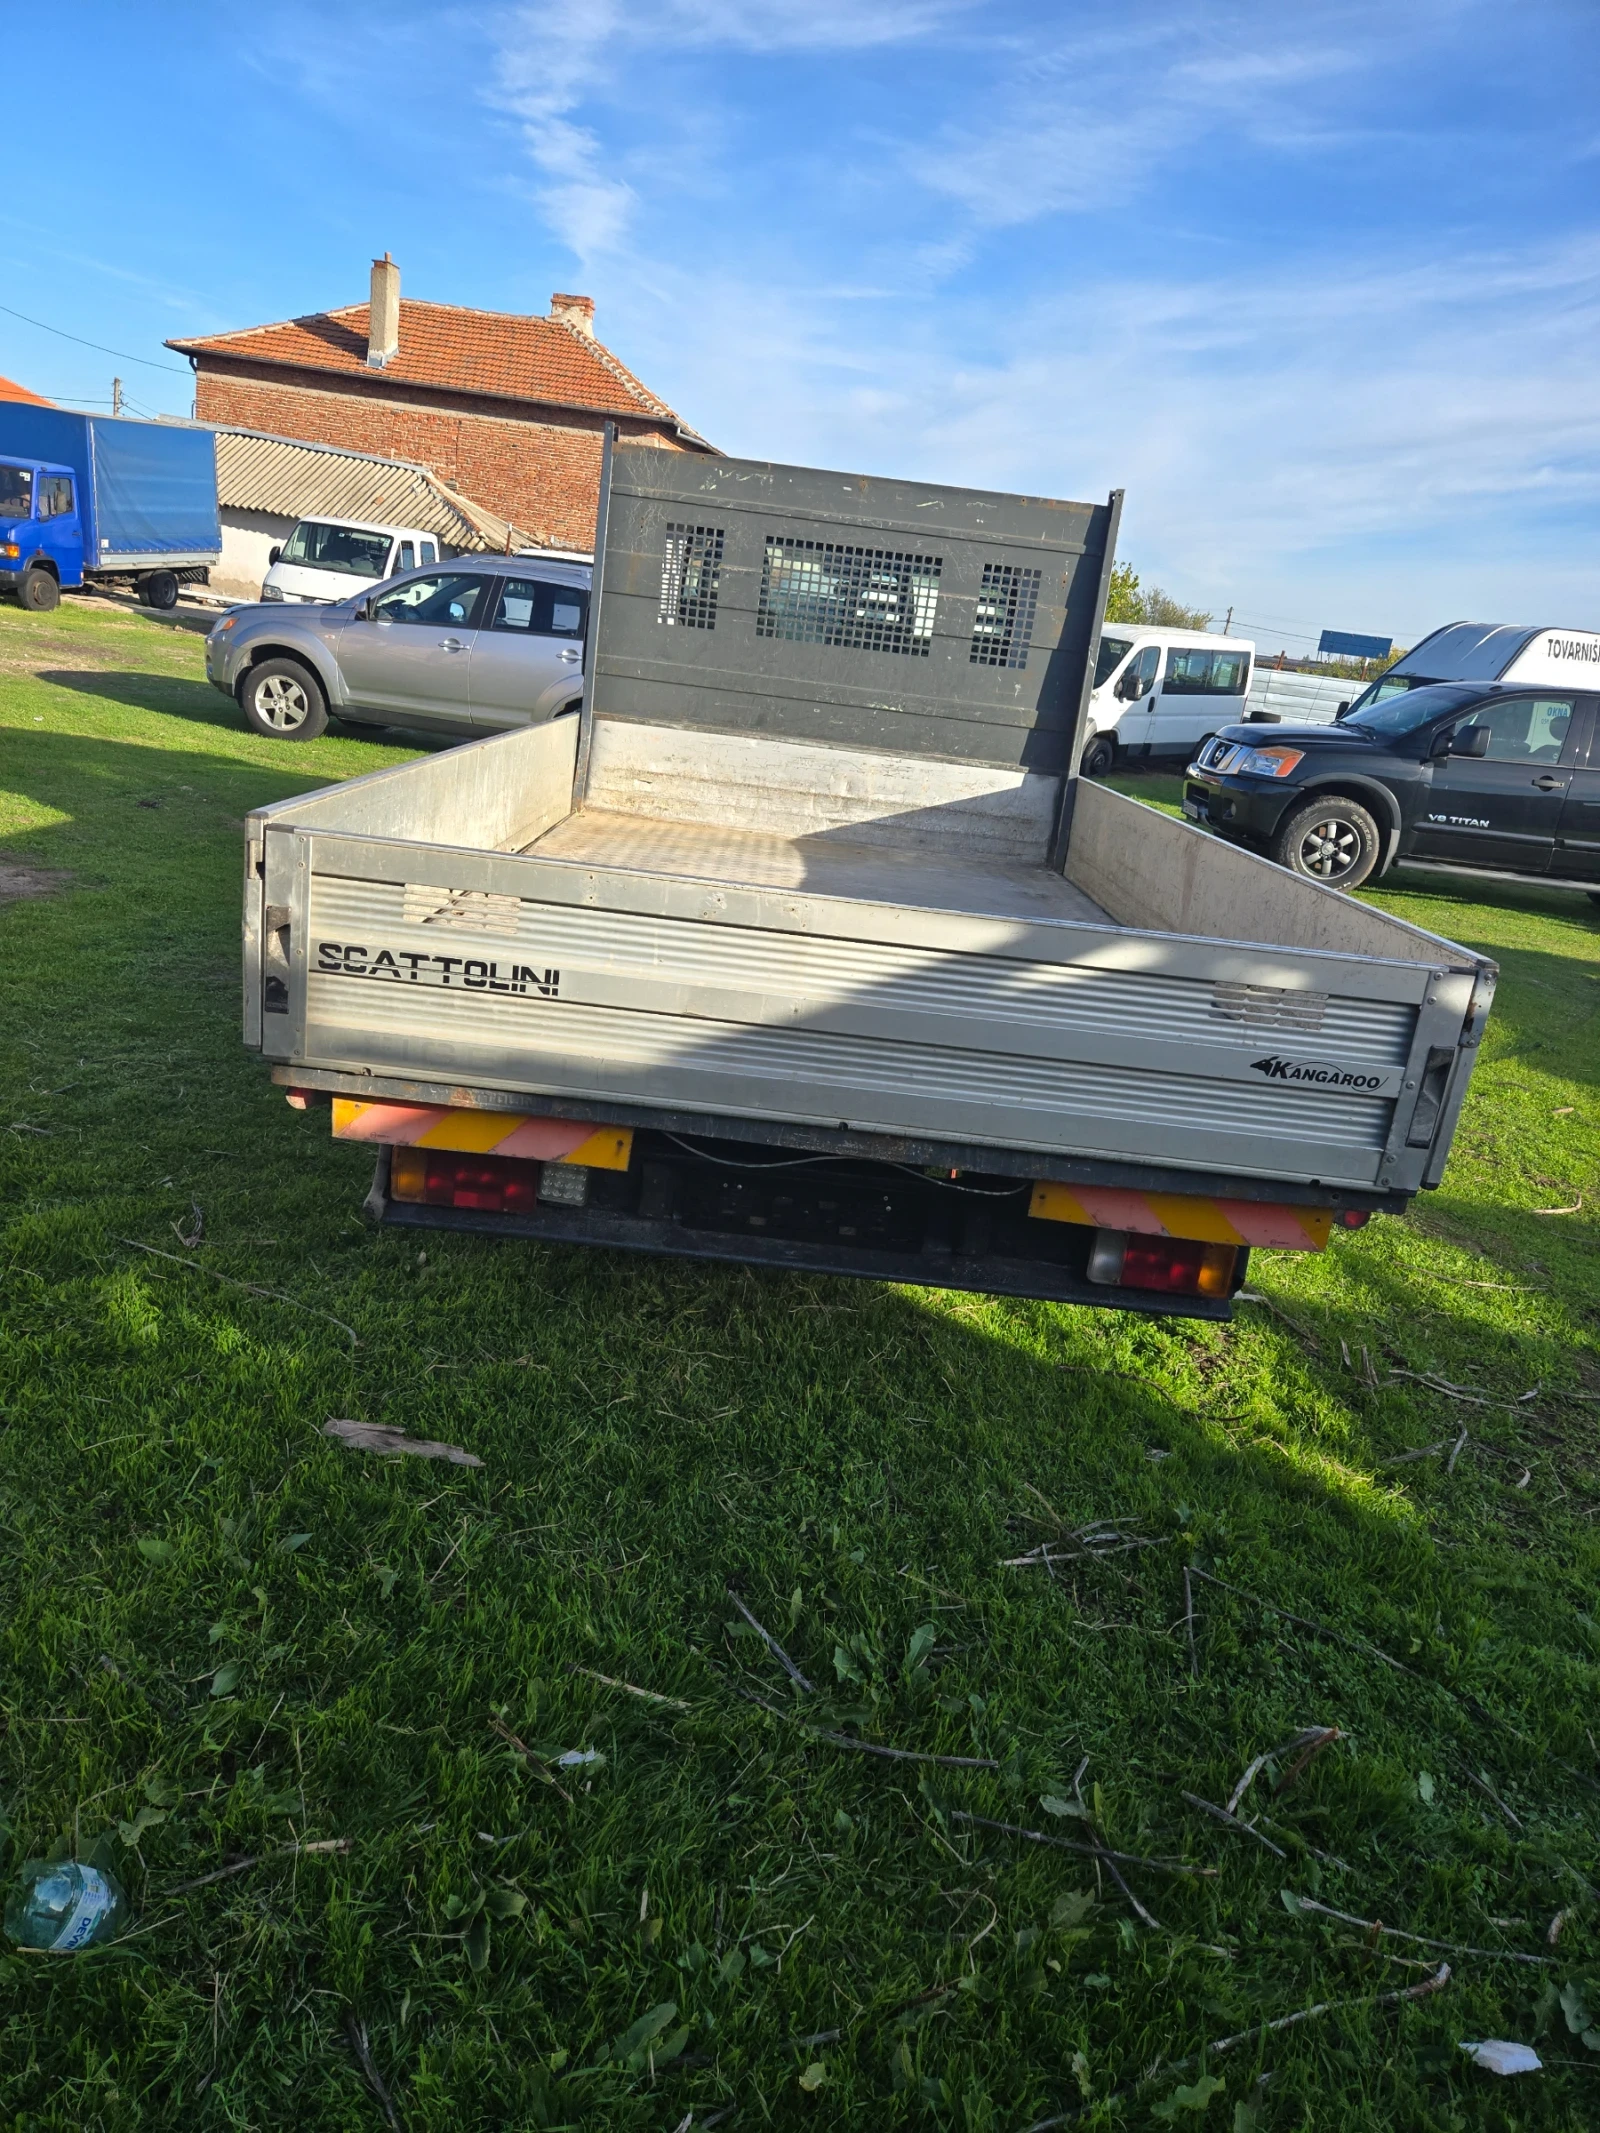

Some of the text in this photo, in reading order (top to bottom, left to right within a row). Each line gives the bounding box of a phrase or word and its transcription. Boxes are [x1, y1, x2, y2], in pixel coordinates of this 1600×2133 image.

[1547, 638, 1600, 663] TOVARNIŠ
[1428, 813, 1490, 828] V8 TITAN
[318, 942, 560, 996] SCATTOLINI
[1269, 1060, 1381, 1088] KANGAROO
